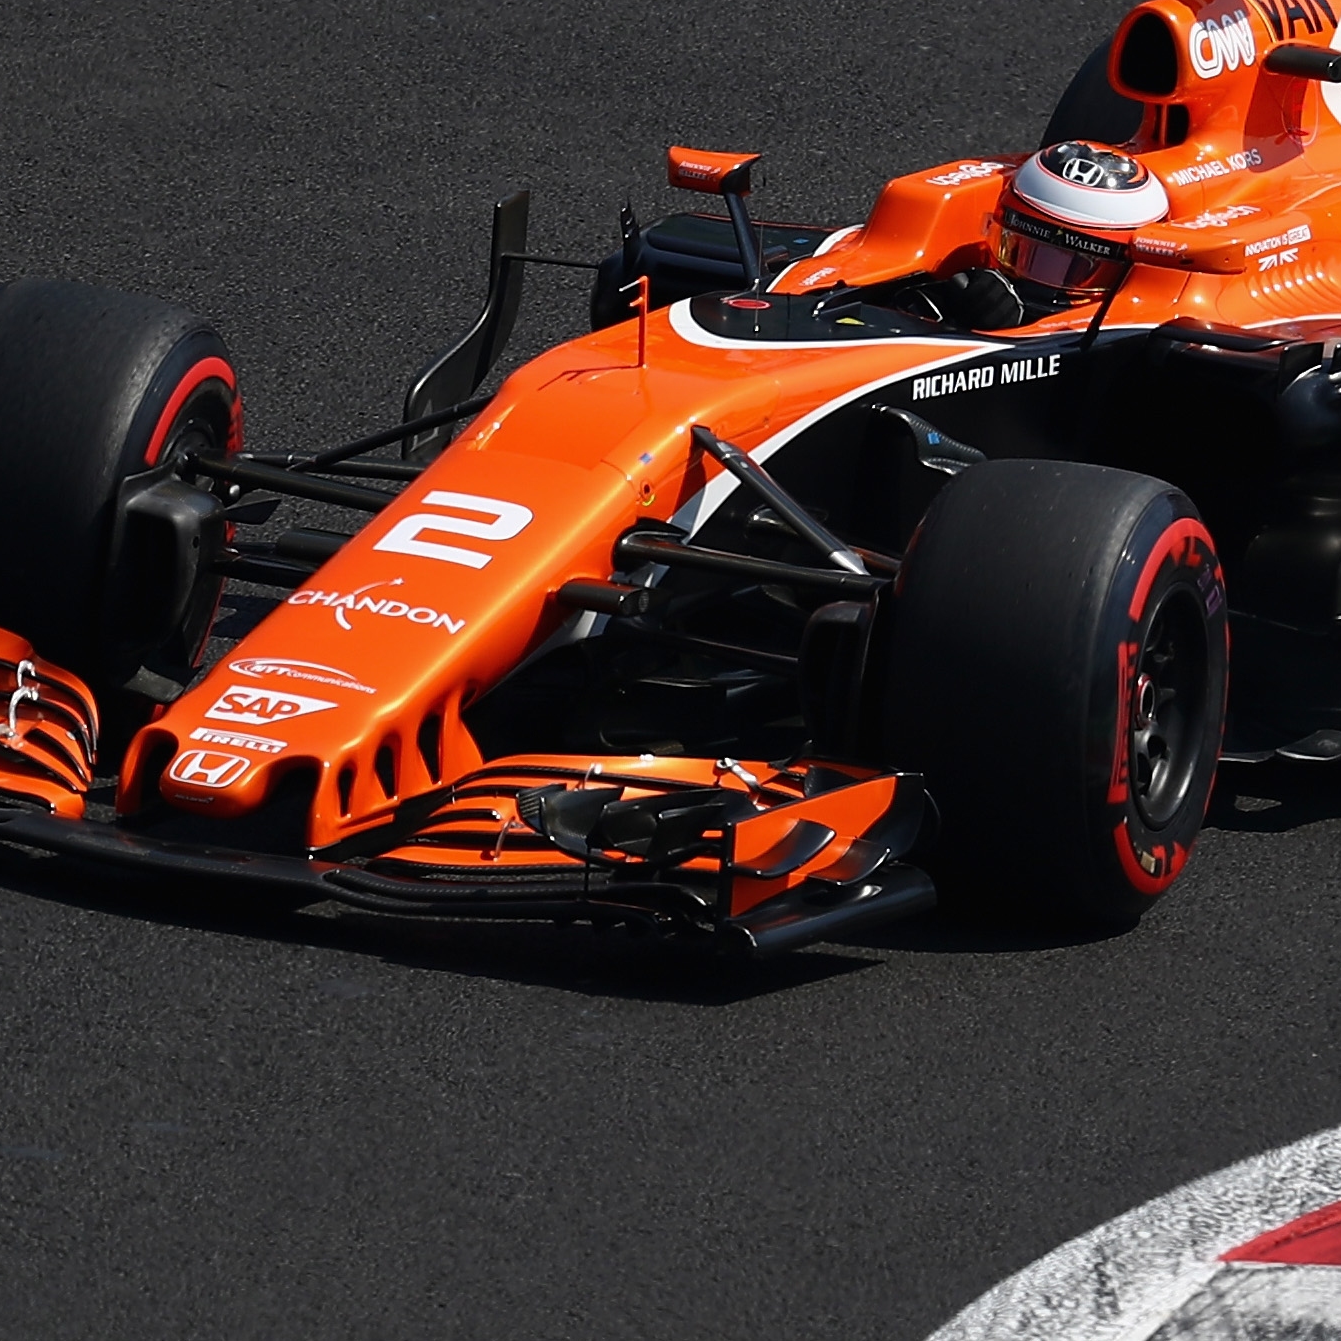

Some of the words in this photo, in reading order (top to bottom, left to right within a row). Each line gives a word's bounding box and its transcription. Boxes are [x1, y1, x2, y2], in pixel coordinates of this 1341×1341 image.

[1189, 8, 1256, 79] CNN
[1172, 160, 1230, 186] MICHAEL
[1226, 148, 1262, 171] KORS
[1010, 214, 1051, 239] JOHNNIE
[1065, 233, 1111, 256] WALKER
[912, 366, 994, 401] RICHARD
[1000, 354, 1061, 385] MILLE
[373, 490, 534, 570] 2
[288, 585, 467, 635] CHANDON
[213, 692, 302, 720] SAP
[189, 726, 289, 754] PIRELLI
